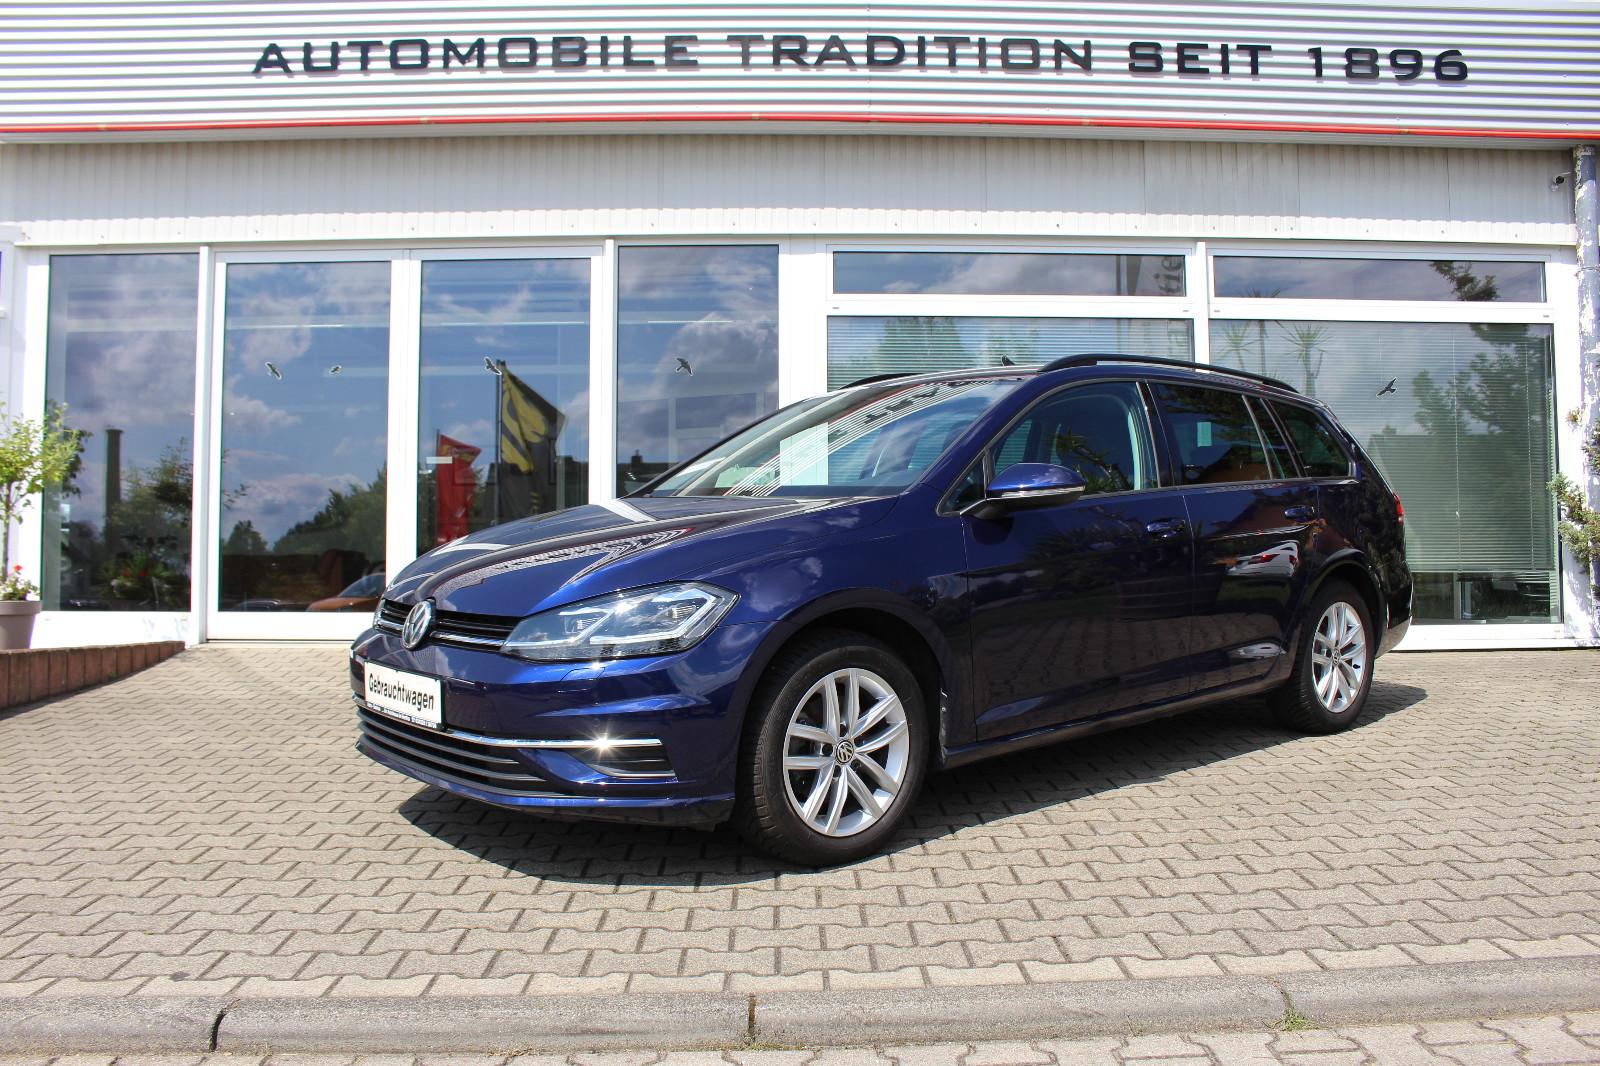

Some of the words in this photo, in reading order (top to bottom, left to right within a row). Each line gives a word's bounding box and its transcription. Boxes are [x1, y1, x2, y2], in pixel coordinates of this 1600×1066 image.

[252, 34, 699, 75] AUTOMOBILE
[727, 34, 1093, 71] TRADITION
[1128, 41, 1273, 77] SEIT
[1307, 46, 1470, 82] 1896
[368, 672, 435, 712] Gebrauchtwagen
